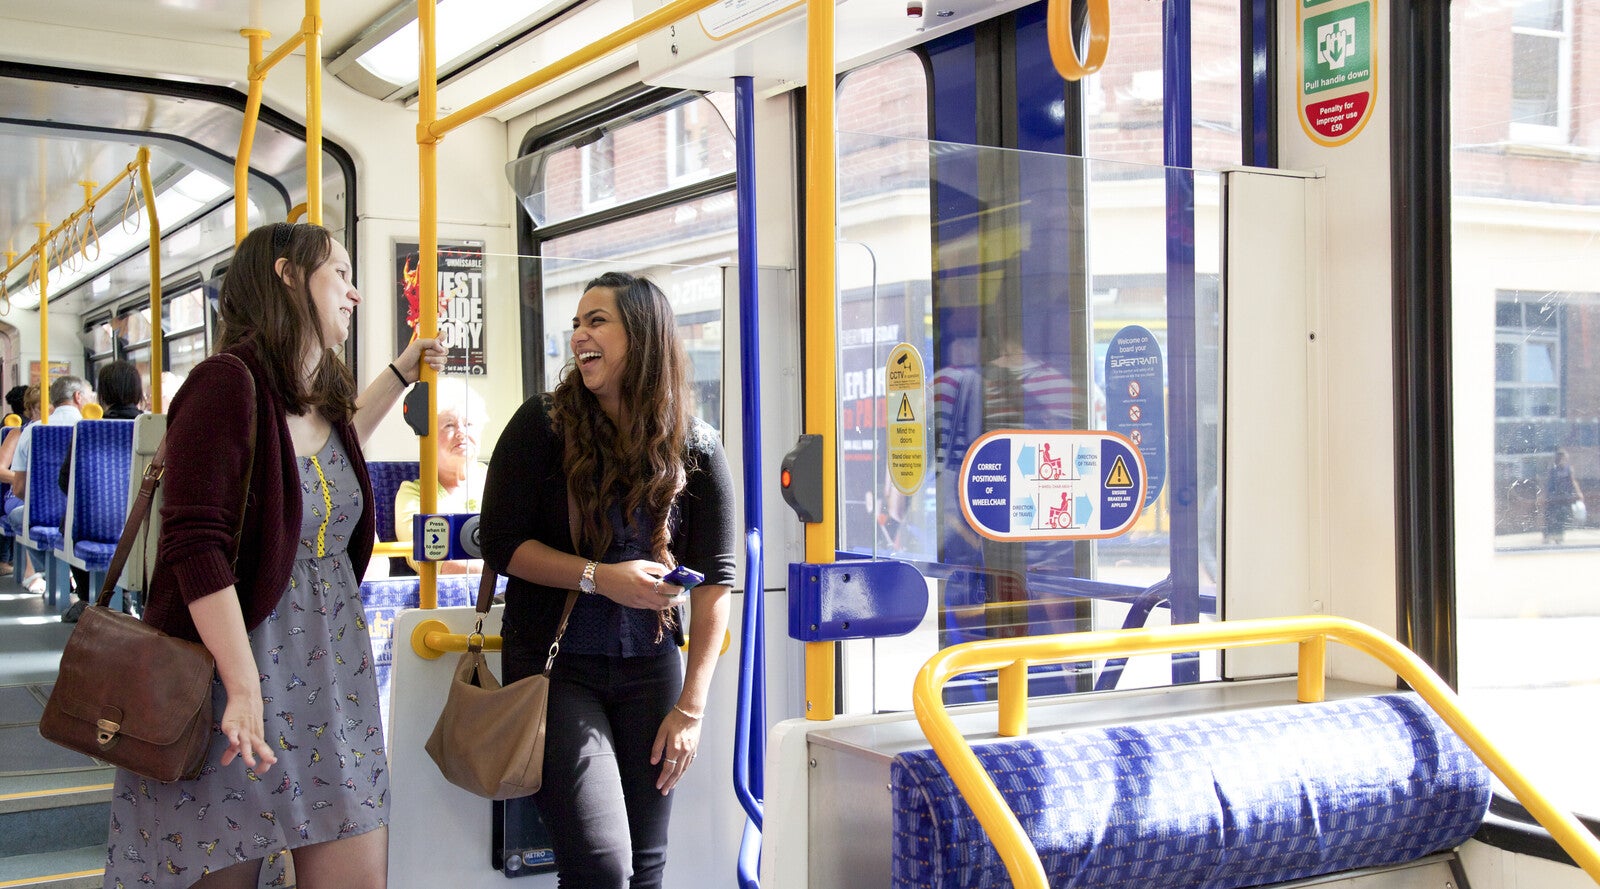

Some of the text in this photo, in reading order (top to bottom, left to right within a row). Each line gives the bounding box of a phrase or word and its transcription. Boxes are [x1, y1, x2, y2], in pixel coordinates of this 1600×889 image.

[671, 25, 675, 37] 3
[1305, 69, 1368, 90] Pull handle down
[1320, 104, 1343, 115] Penalty
[1331, 124, 1342, 132] £50
[438, 272, 482, 298] EST
[1111, 356, 1158, 367] SUPERTRAM
[890, 371, 904, 380] CCTV
